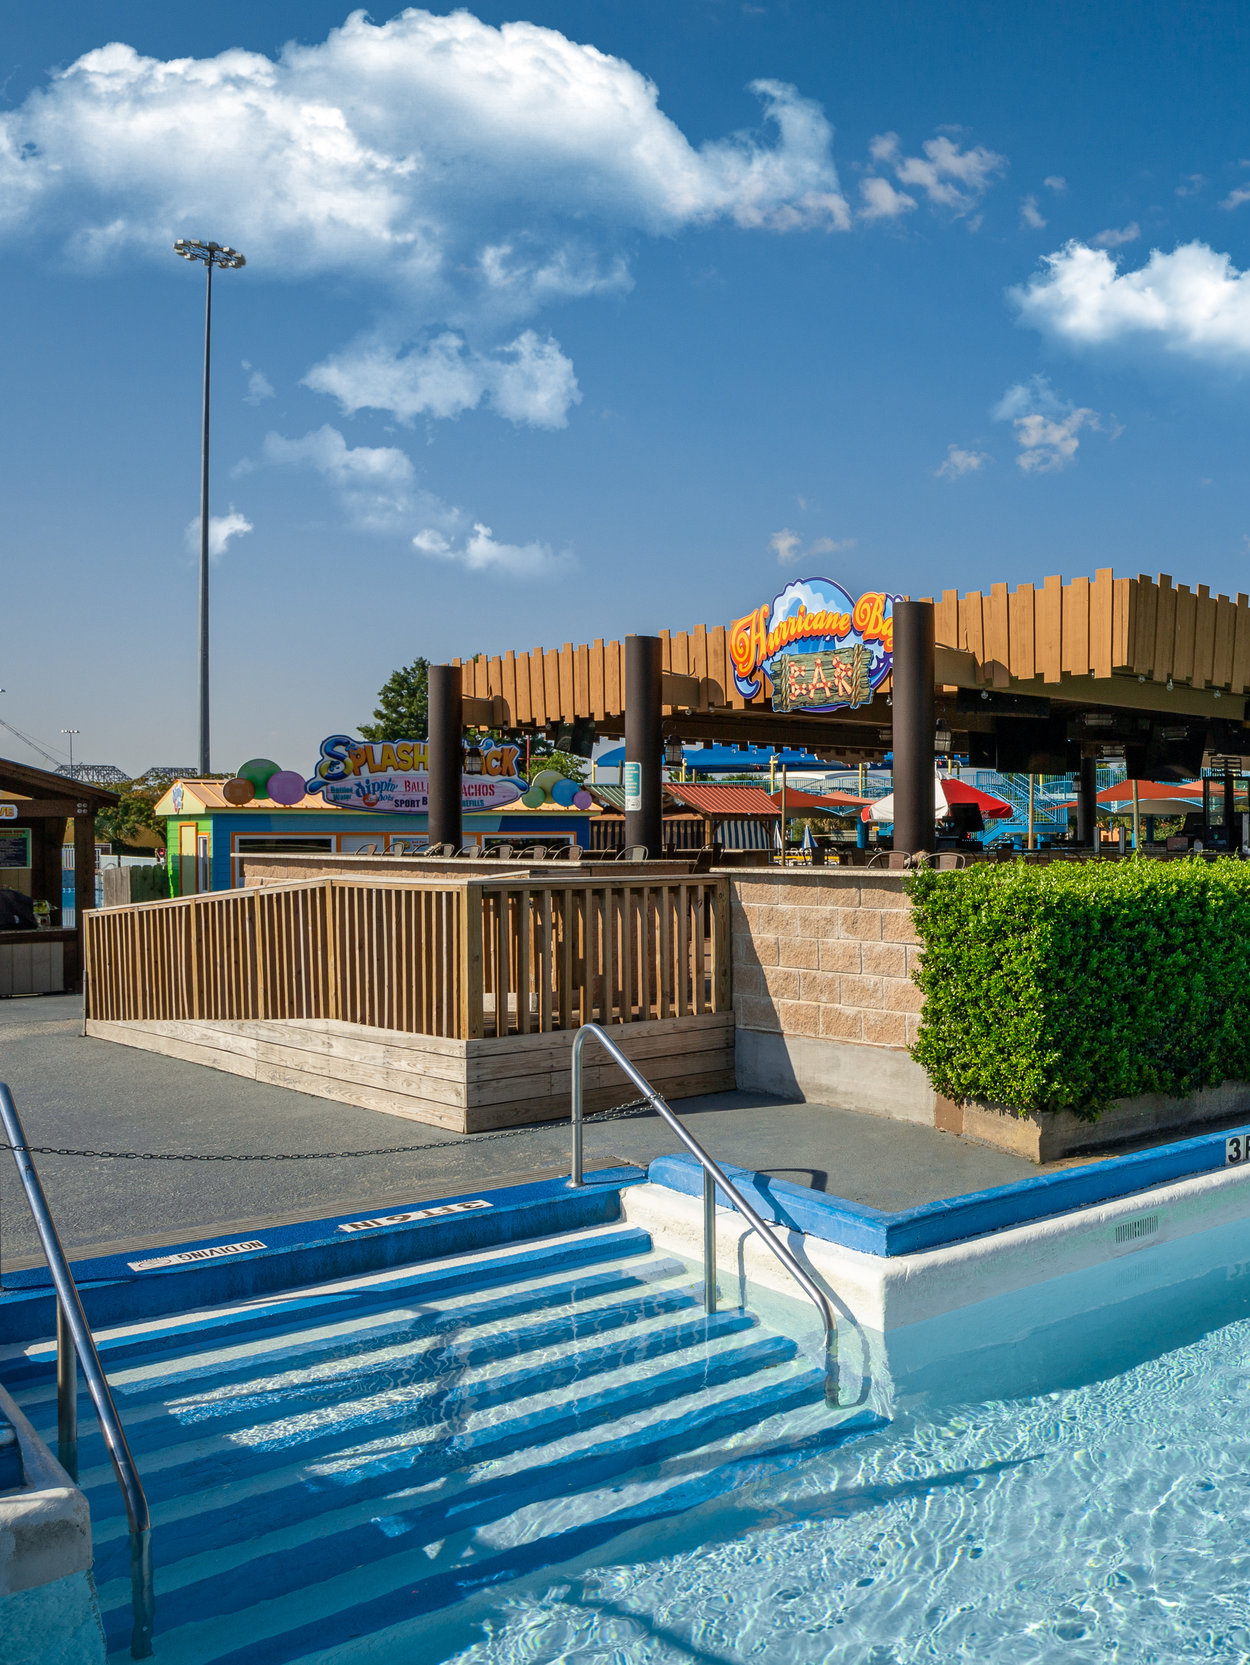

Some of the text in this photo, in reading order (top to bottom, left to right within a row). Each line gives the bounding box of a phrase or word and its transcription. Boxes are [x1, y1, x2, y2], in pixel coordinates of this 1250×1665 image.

[730, 592, 893, 678] Hurricane Ba
[788, 655, 853, 700] BAR
[319, 738, 429, 780] SPLASH
[394, 798, 421, 808] SPORT
[462, 784, 496, 797] ACHOS
[1228, 1137, 1241, 1164] 3
[349, 1201, 484, 1230] 3 FT 6 IN
[177, 1244, 239, 1261] DIVING
[240, 1240, 264, 1251] NO
